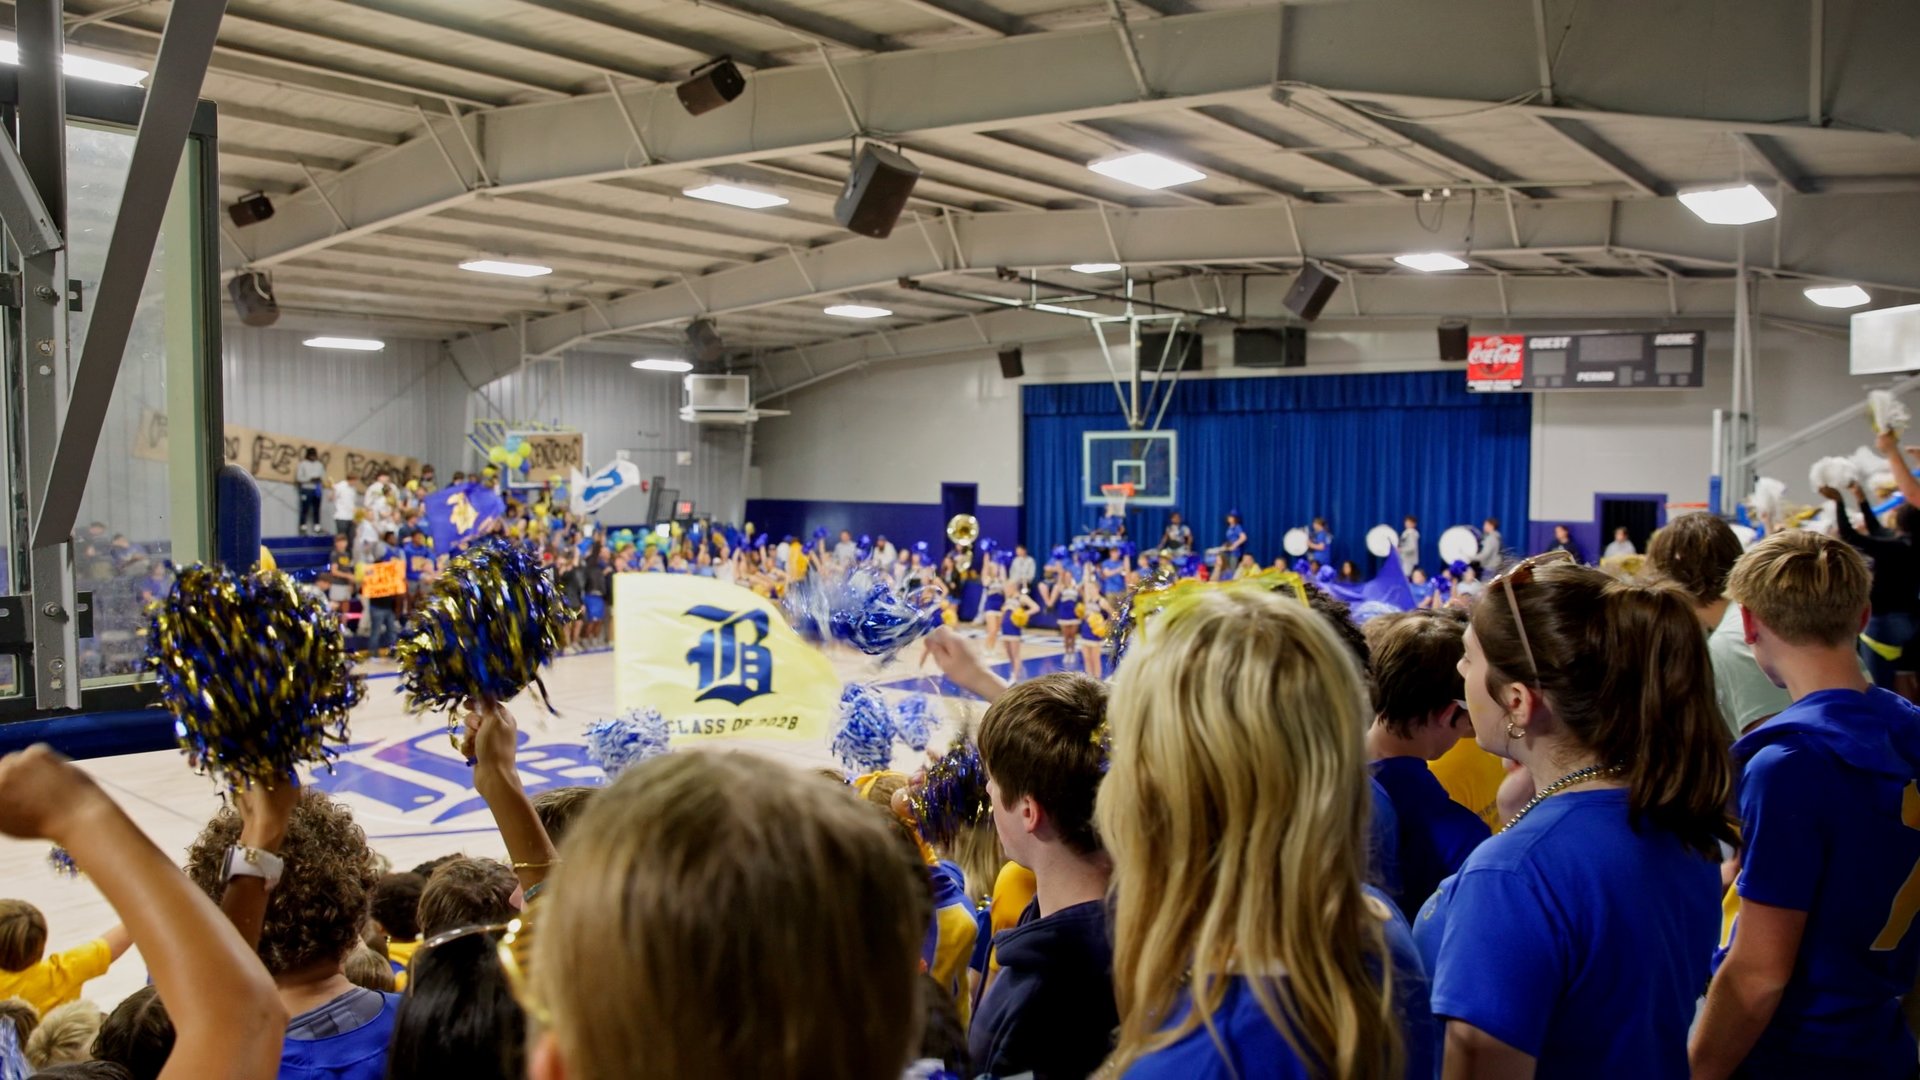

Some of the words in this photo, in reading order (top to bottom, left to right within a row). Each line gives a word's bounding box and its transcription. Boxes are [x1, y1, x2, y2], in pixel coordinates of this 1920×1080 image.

[1529, 337, 1571, 349] GUEST
[1654, 333, 1696, 346] HOME
[1576, 371, 1615, 382] PERIOD
[681, 604, 778, 707] B
[663, 718, 726, 734] CLASS
